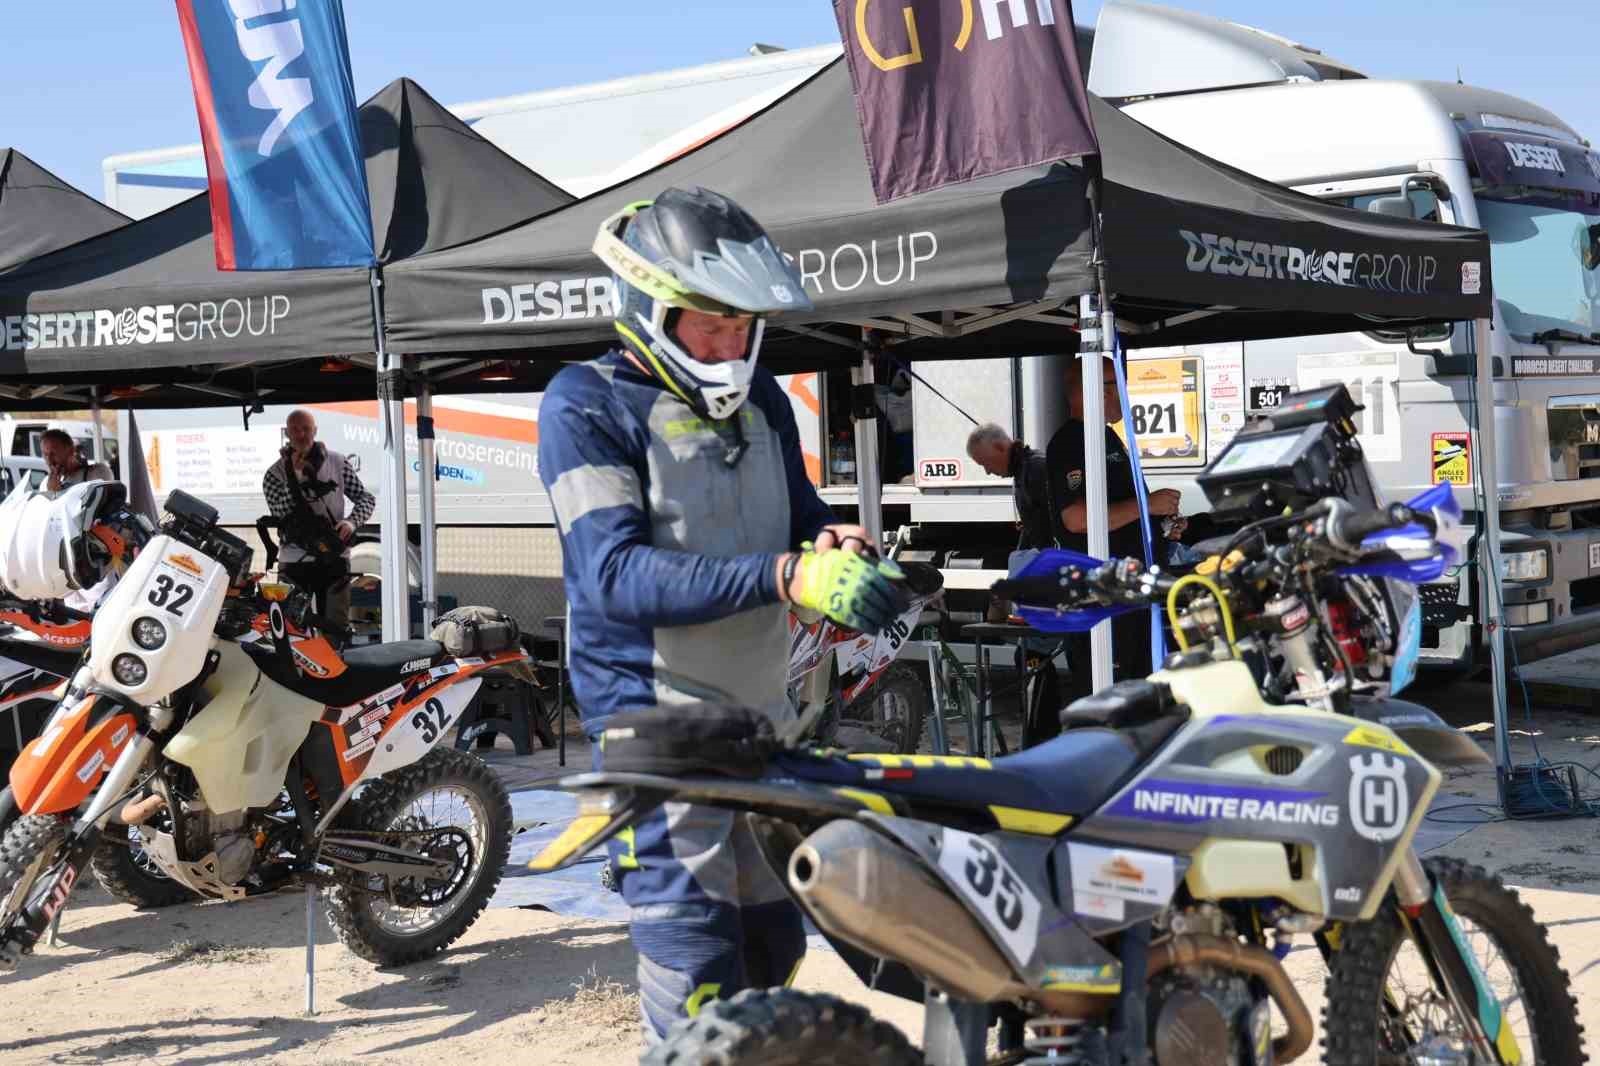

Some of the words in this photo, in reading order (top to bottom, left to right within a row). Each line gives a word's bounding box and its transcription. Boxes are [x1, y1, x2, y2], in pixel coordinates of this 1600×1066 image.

[1514, 360, 1547, 374] MOROCCO
[1548, 360, 1567, 373] DESERT
[1259, 391, 1282, 406] 501
[1131, 402, 1177, 435] 821
[924, 463, 957, 477] ARB
[148, 574, 194, 617] 32
[412, 697, 452, 744] 32
[1239, 797, 1340, 827] RACING
[964, 838, 1023, 932] 35
